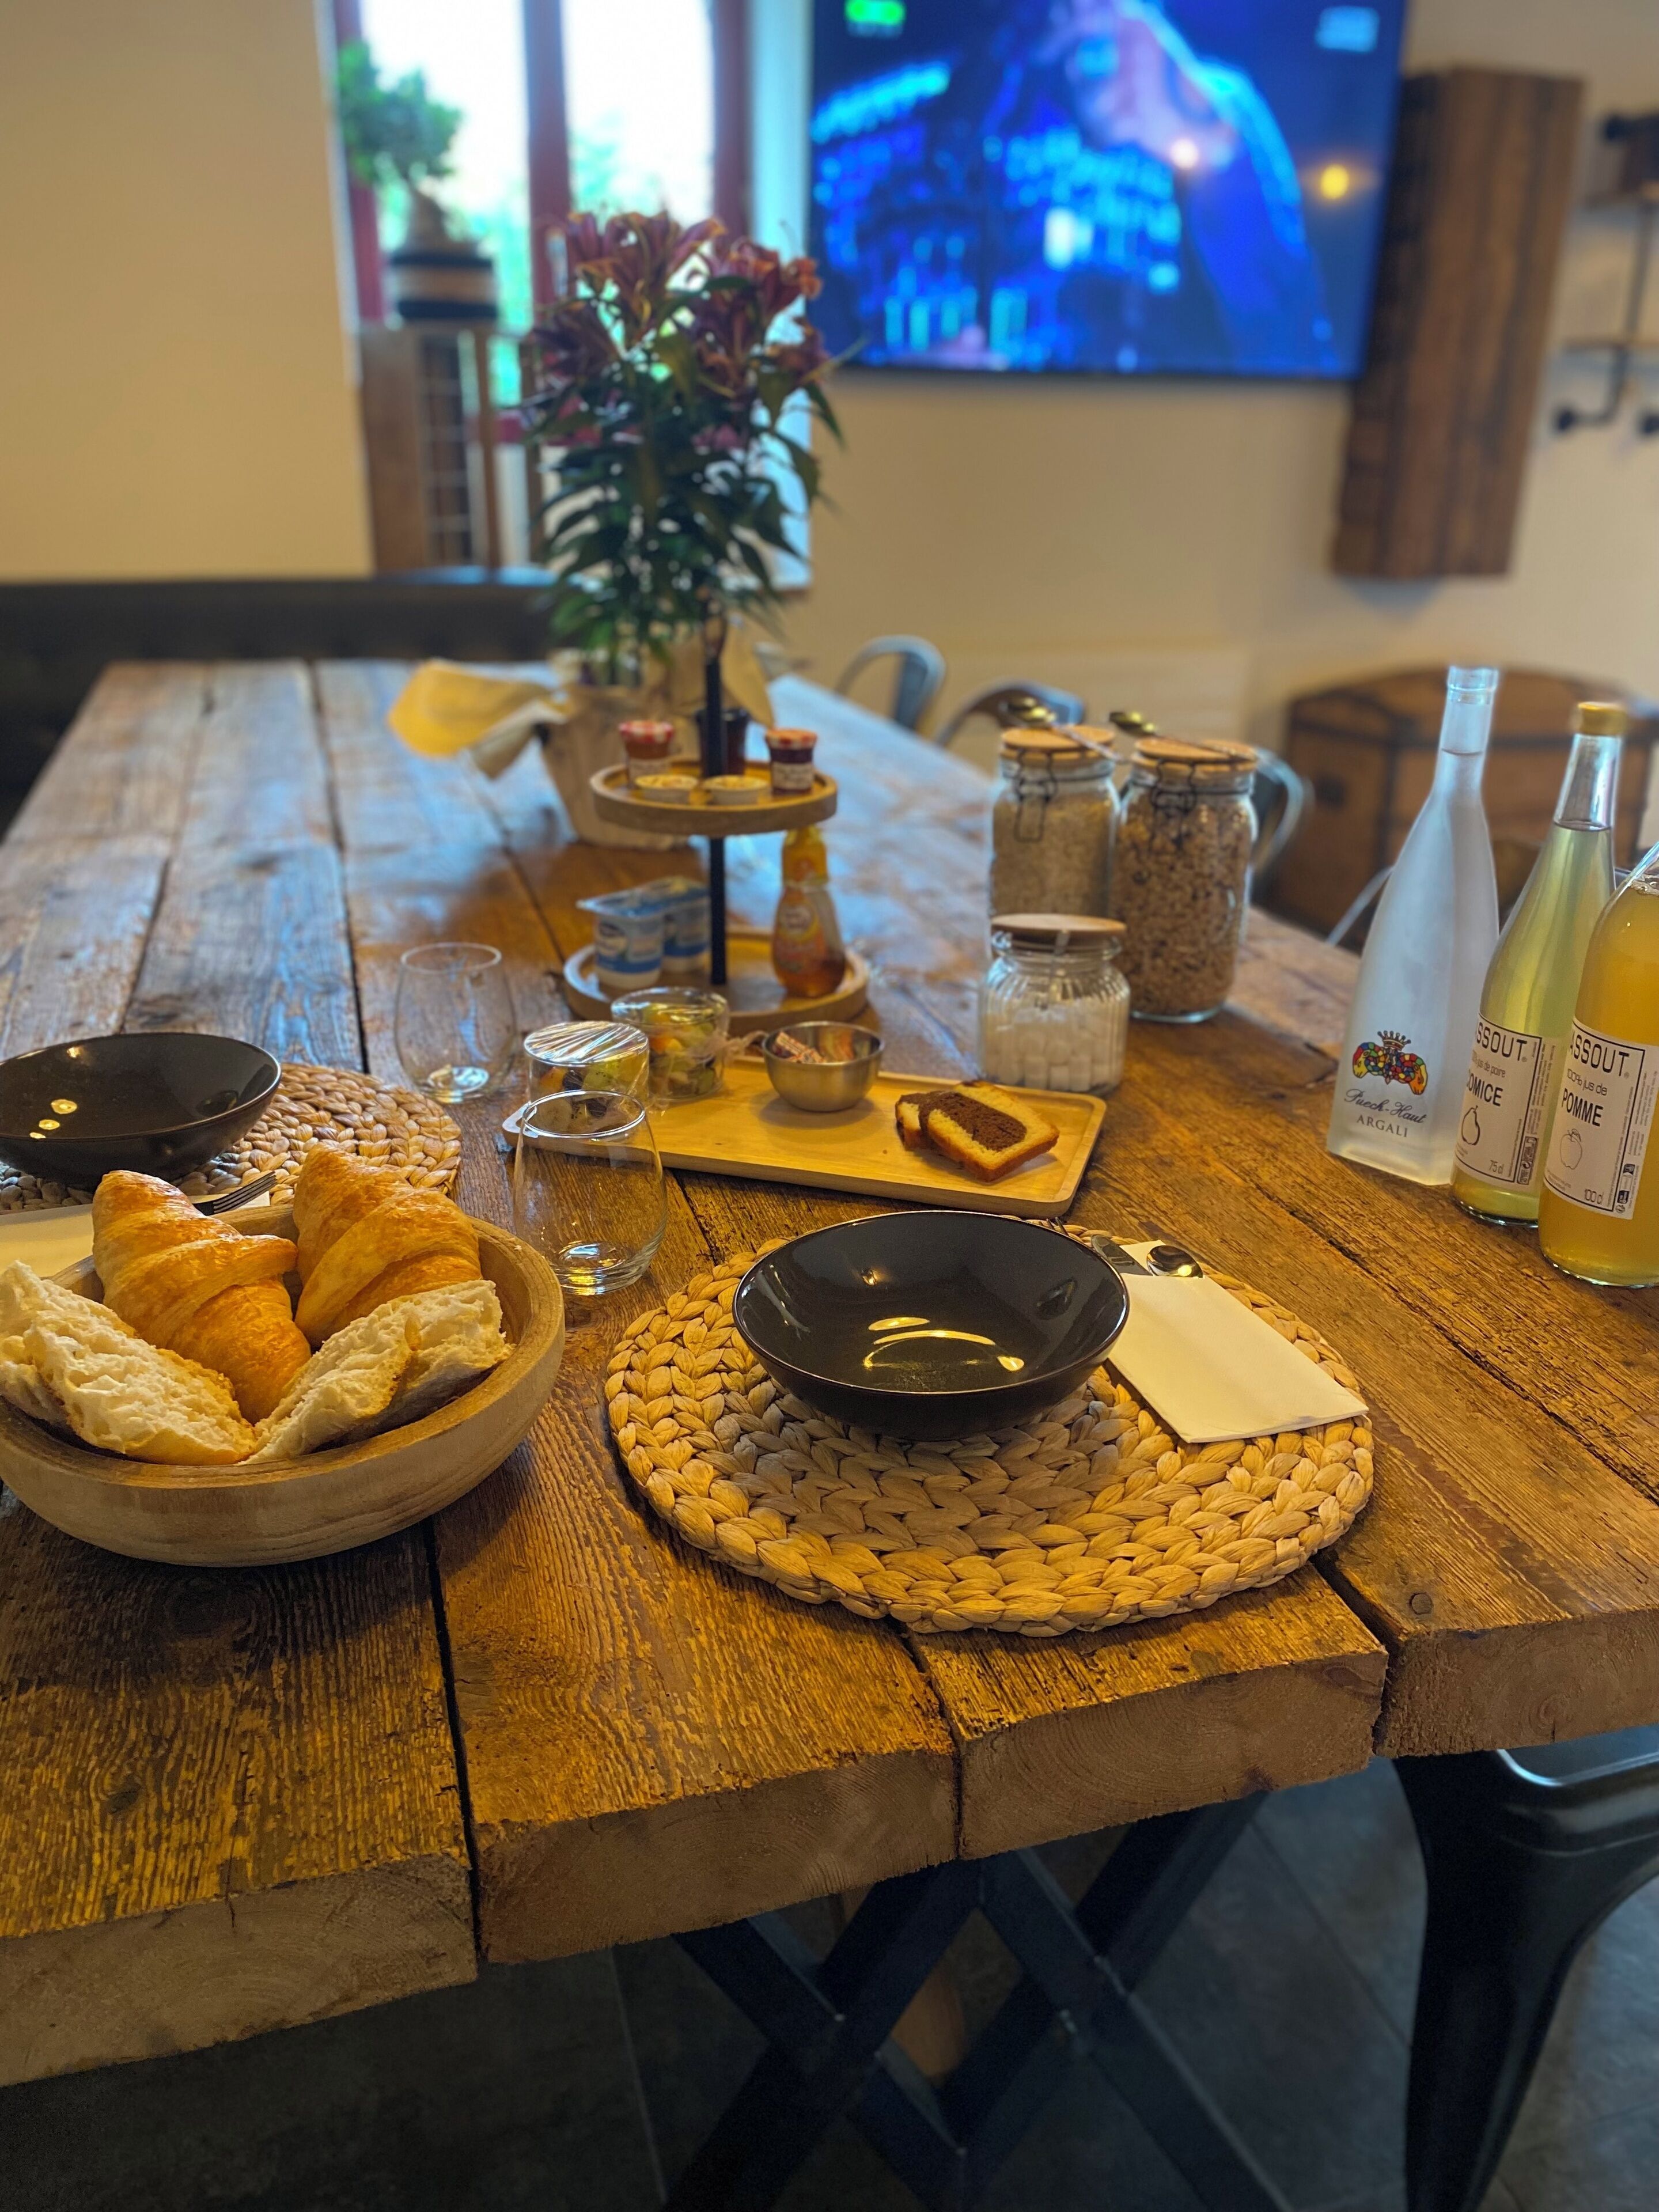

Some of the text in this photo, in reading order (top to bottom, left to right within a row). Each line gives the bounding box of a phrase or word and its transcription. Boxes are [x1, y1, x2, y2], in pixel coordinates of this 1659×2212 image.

[1475, 1021, 1528, 1061] SSOUT
[1467, 1070, 1503, 1107] OMICE
[1582, 1078, 1595, 1092] jus
[1595, 1083, 1608, 1096] de
[1344, 1088, 1427, 1123] Puech-Haut
[1561, 1088, 1604, 1127] POMME
[1356, 1114, 1408, 1138] ARGALI
[1489, 1159, 1498, 1173] 75
